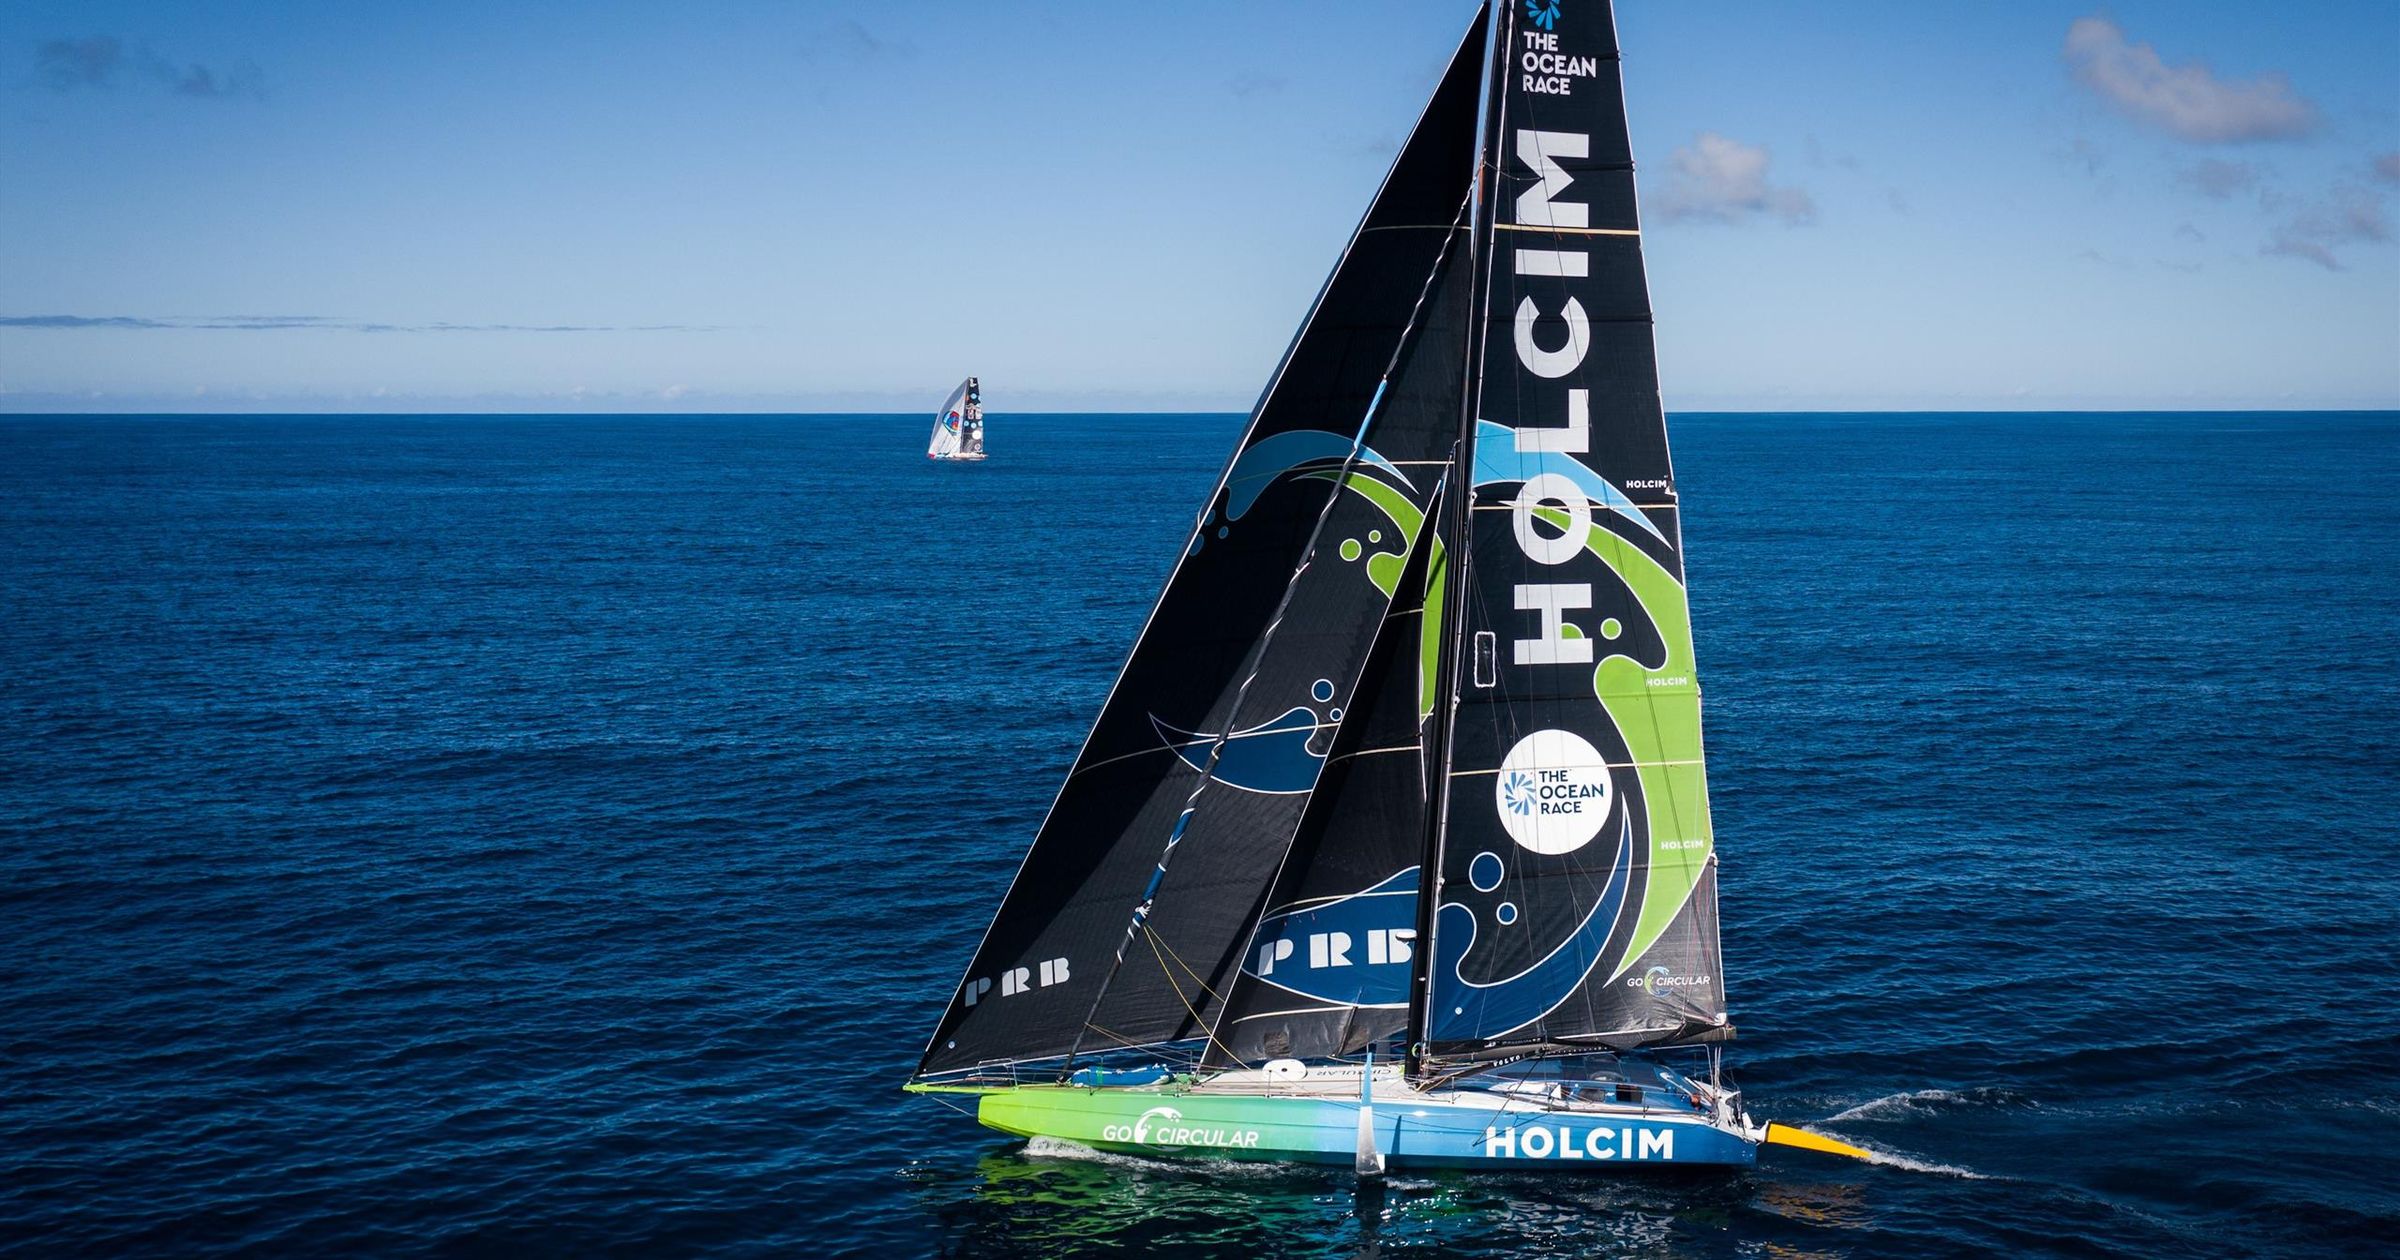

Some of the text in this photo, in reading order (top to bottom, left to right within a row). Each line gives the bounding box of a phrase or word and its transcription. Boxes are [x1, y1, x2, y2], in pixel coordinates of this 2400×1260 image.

[1523, 31, 1558, 51] THE
[1522, 51, 1597, 78] OCEAN
[1522, 74, 1571, 95] RACE
[1513, 129, 1593, 665] HOLCIM
[1626, 480, 1667, 488] HOLCIM
[1646, 677, 1687, 686] HOLCIM
[1538, 770, 1568, 783] THE
[1539, 783, 1604, 799] OCEAN
[1540, 801, 1582, 814] RACE
[1660, 840, 1704, 849] HOLCIM
[964, 957, 1071, 1008] PRB
[1626, 975, 1711, 987] GO CIRCULAR
[1493, 1054, 1521, 1067] VOLVO
[1103, 1125, 1259, 1148] GO CIRCULAR
[1486, 1126, 1674, 1160] HOLCIM
